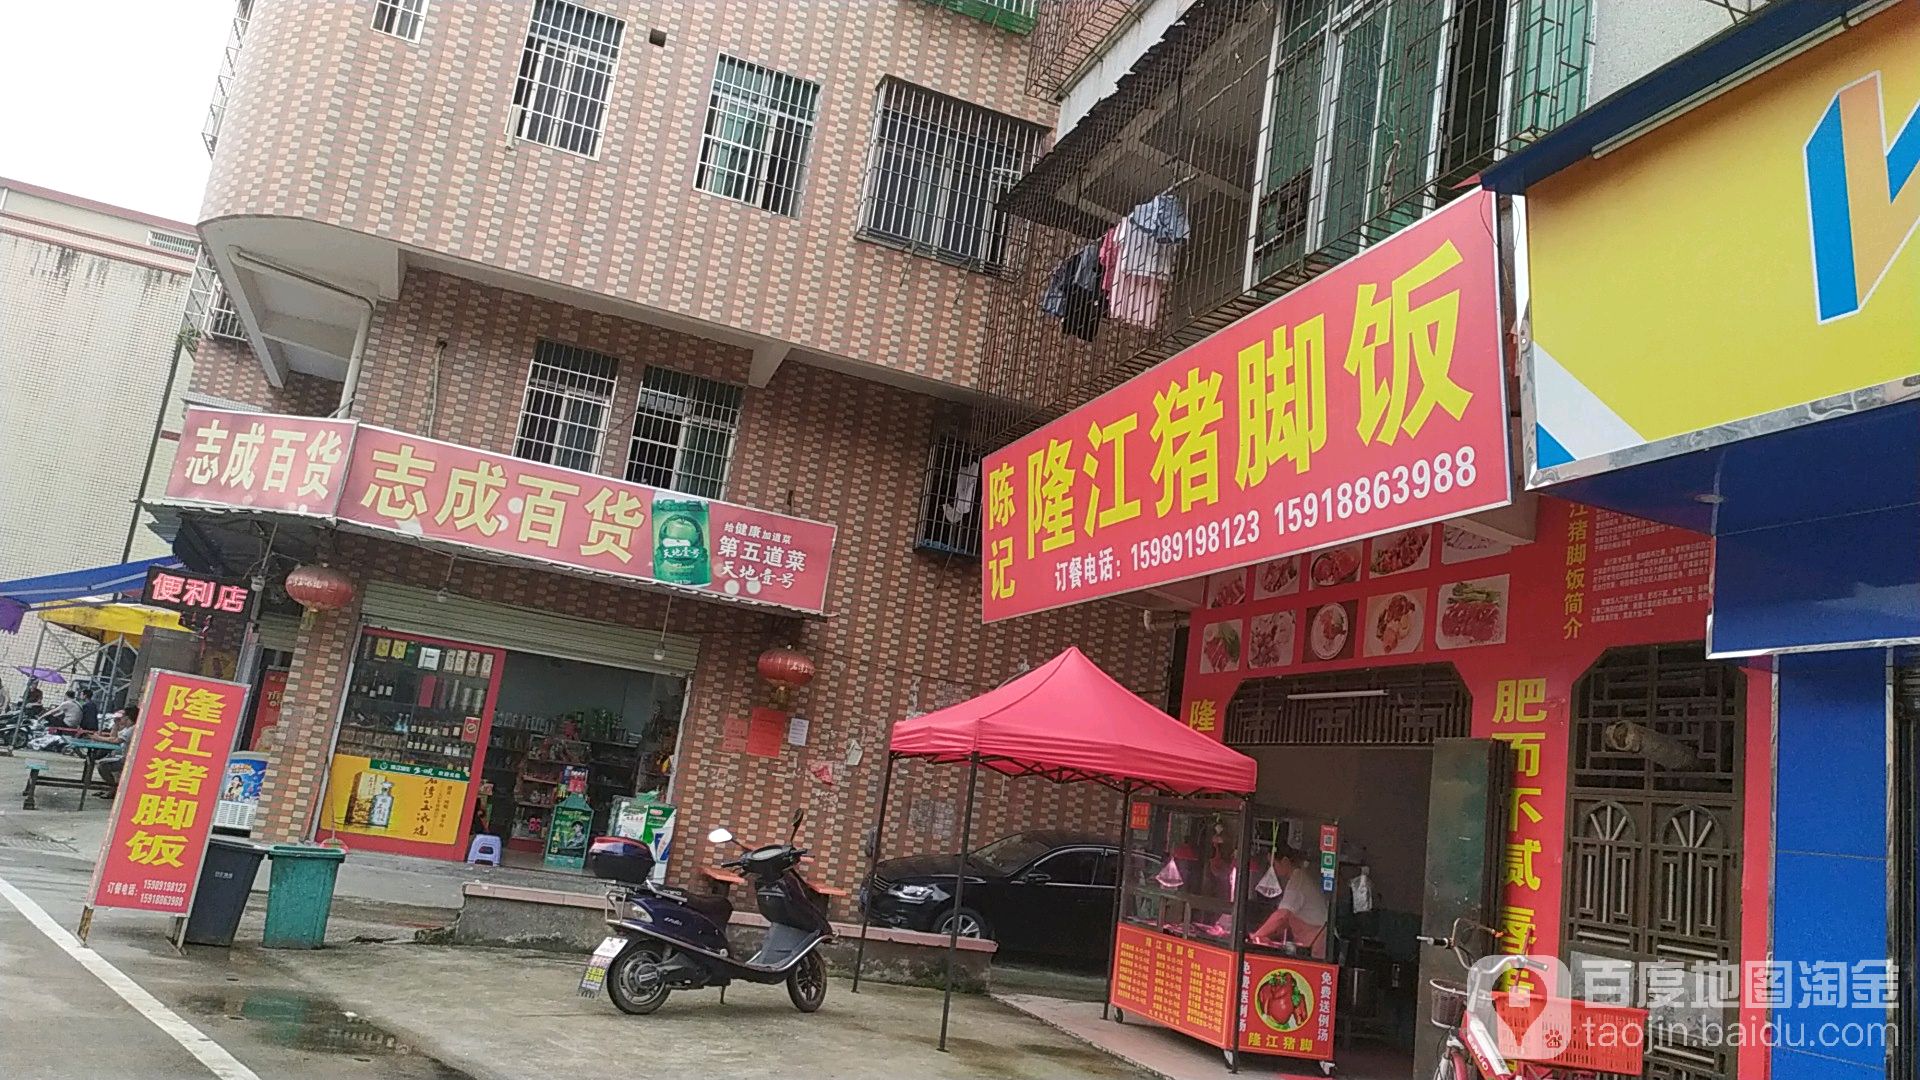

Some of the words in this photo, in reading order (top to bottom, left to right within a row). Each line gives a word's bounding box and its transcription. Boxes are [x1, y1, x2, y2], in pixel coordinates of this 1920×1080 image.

[1027, 239, 1473, 560] 隆江猪脚饭
[185, 418, 343, 502] 志成百货
[361, 445, 646, 564] 志成百货
[724, 521, 793, 545] 给健康加道菜
[988, 463, 1016, 602] 陈记
[1130, 510, 1261, 573] 15989198123
[1274, 446, 1477, 537] 15918863988
[718, 535, 807, 572] 第五道菜
[722, 561, 796, 589] 天地壹号
[152, 573, 249, 613] 便利店
[1189, 699, 1217, 731] 隆
[125, 685, 227, 868] 隆江猪脚饭
[1248, 1032, 1313, 1052] 隆江猪脚
